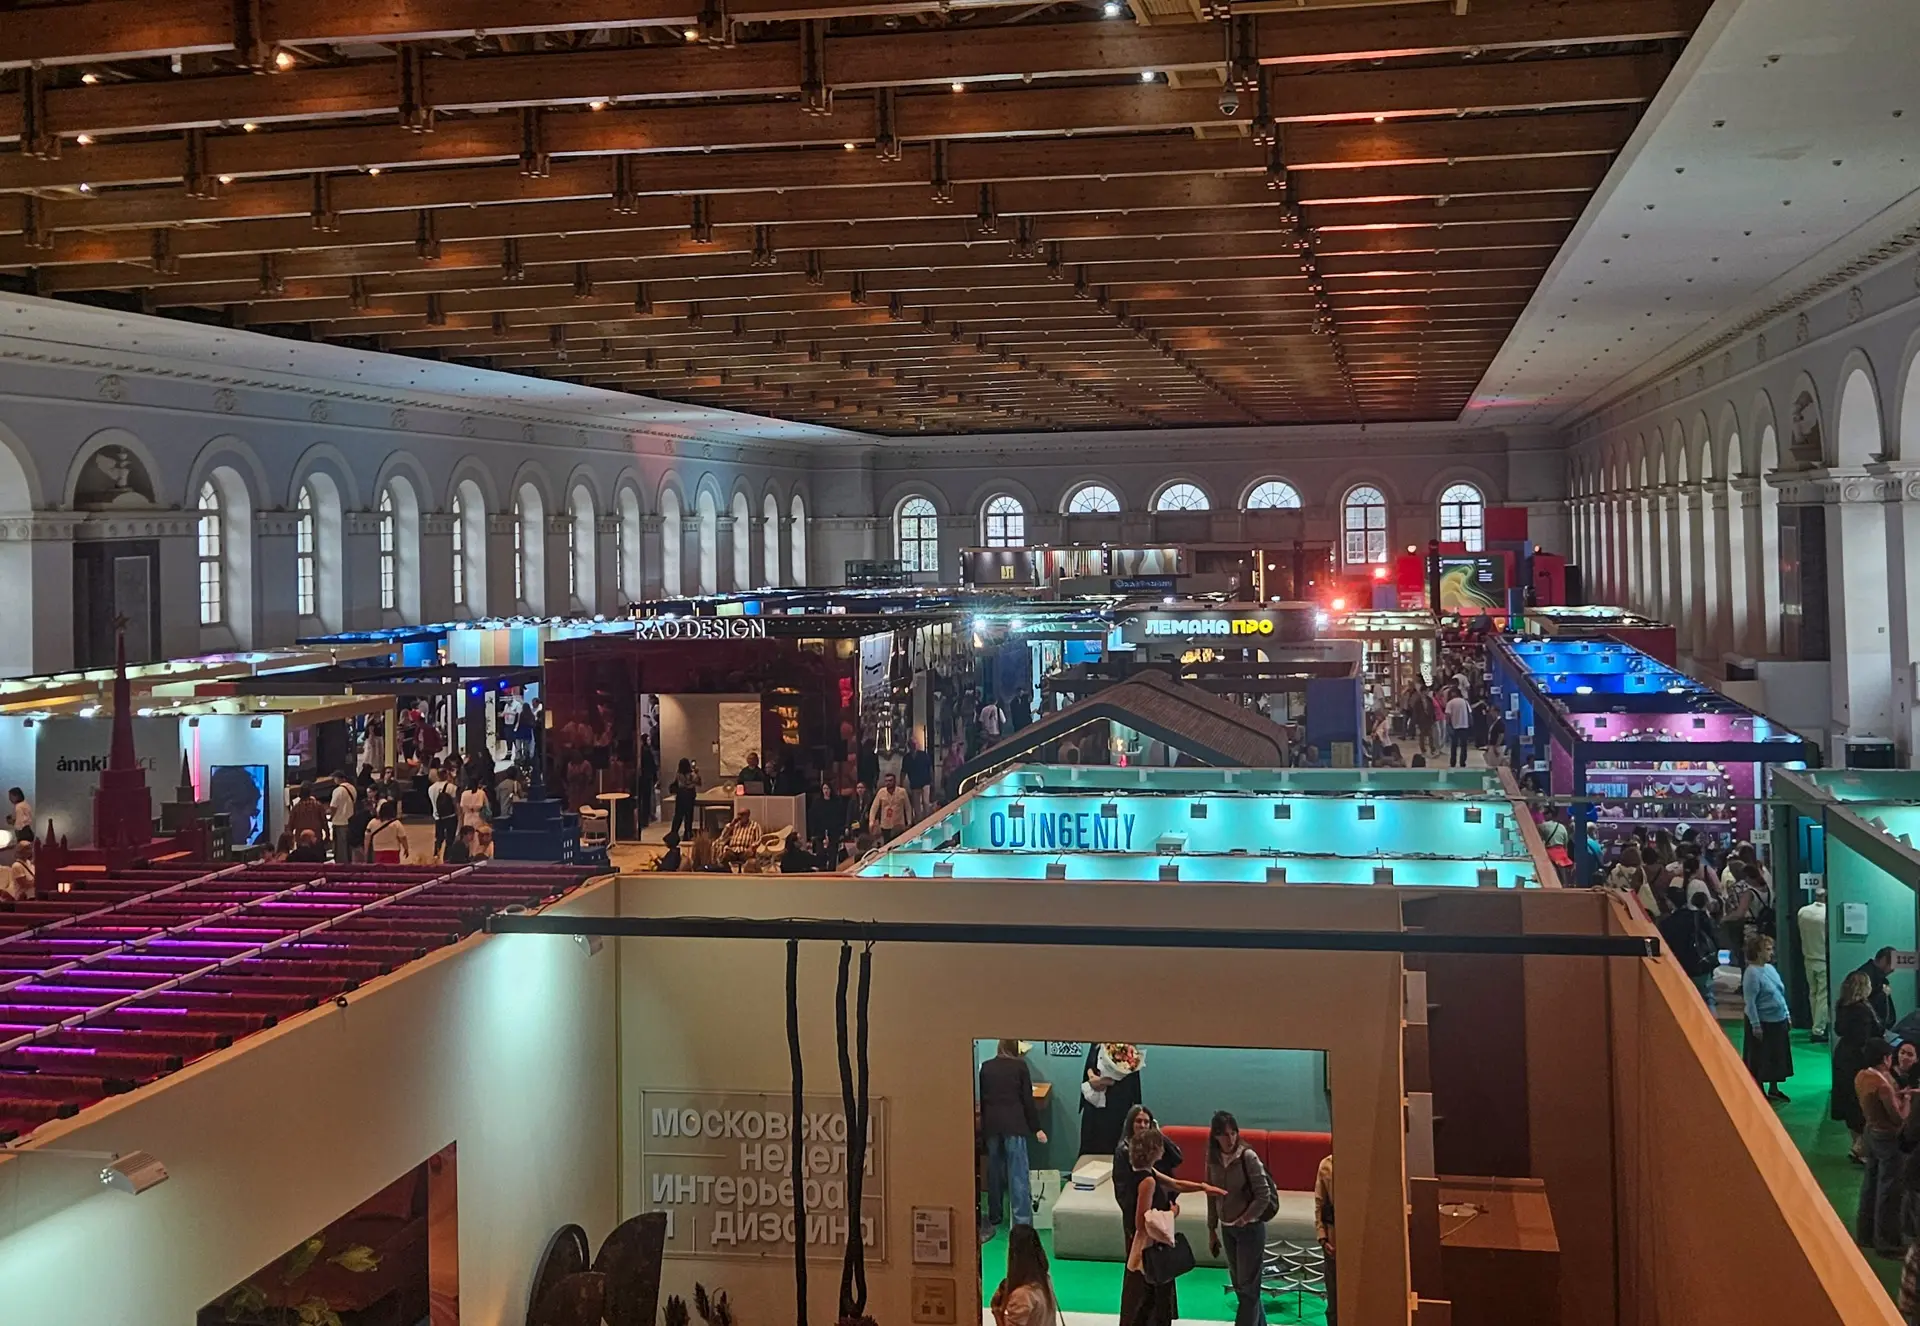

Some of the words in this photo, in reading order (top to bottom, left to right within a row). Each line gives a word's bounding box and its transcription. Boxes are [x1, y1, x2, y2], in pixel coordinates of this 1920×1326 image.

[635, 620, 681, 640] RAD
[686, 619, 766, 640] DESIGN
[1144, 619, 1231, 636] ЛЕМАНА
[1232, 619, 1274, 635] ПРО
[1804, 878, 1820, 886] 11D
[652, 1172, 845, 1214] интерьера
